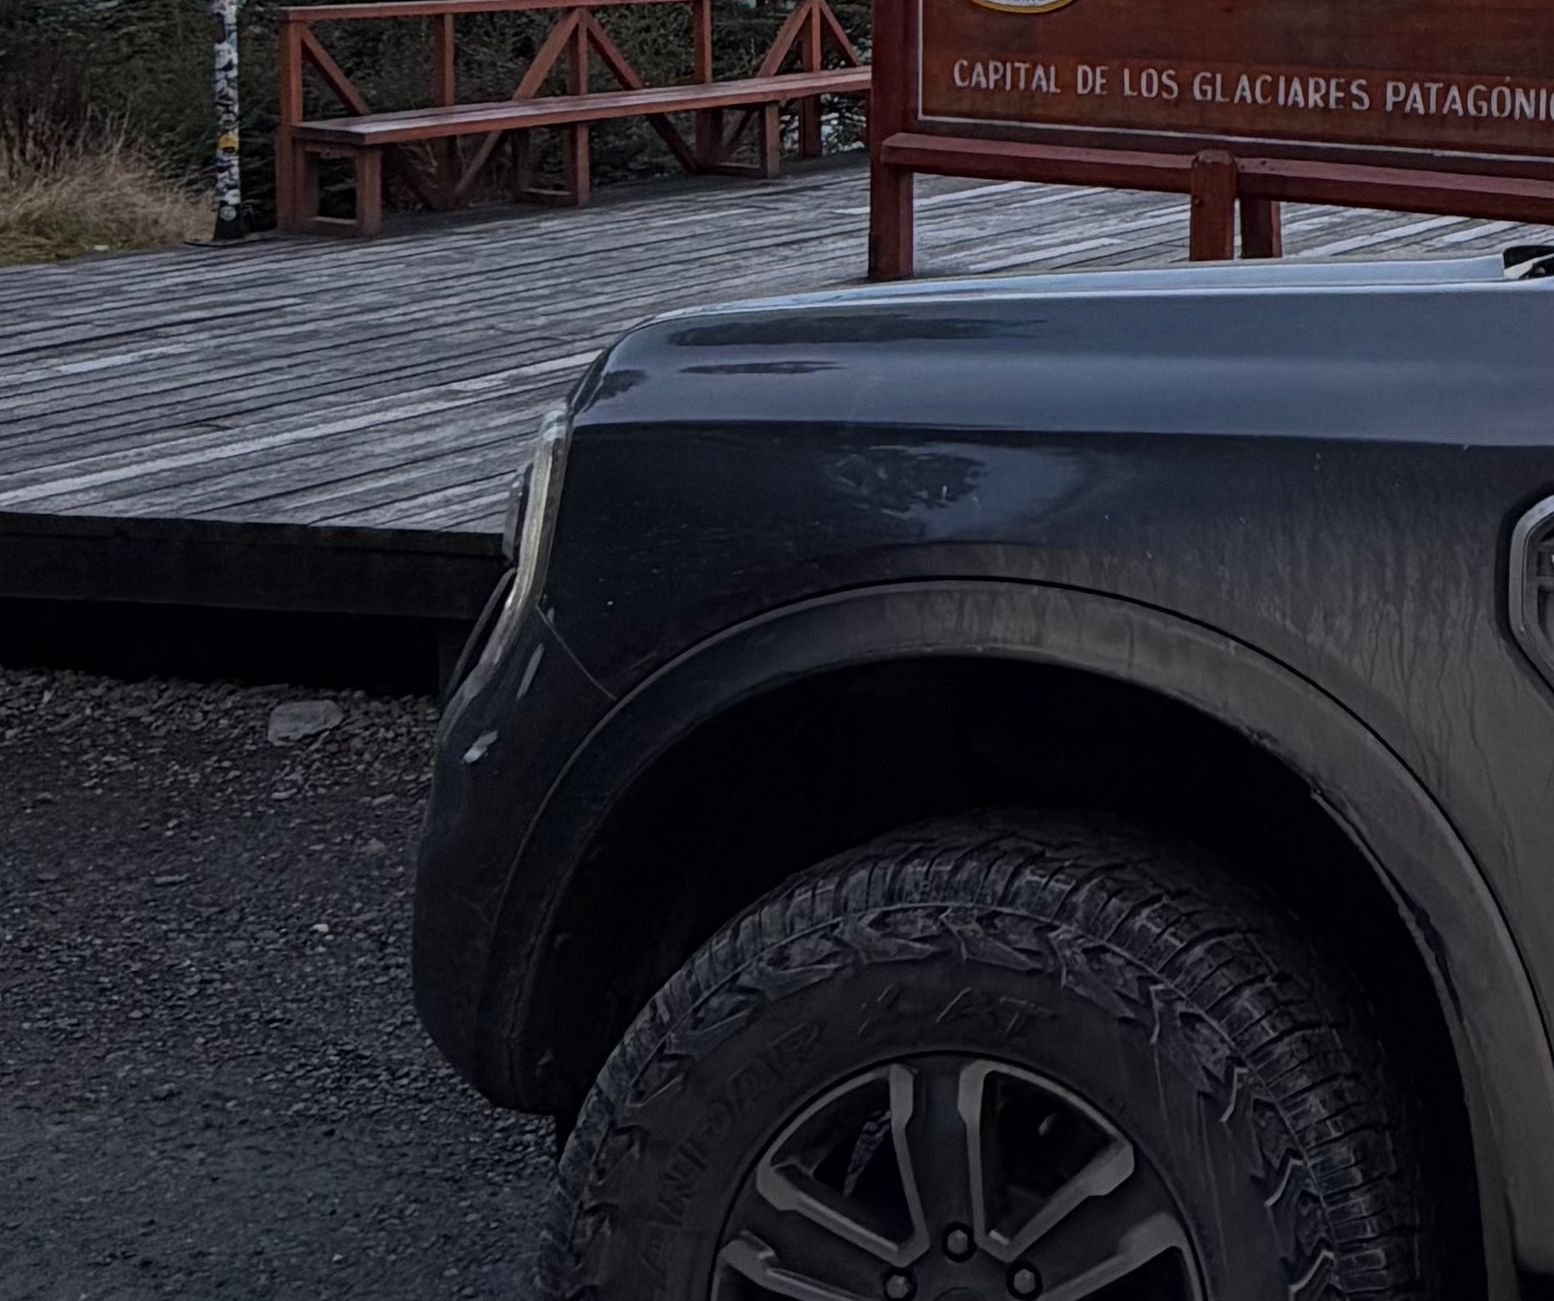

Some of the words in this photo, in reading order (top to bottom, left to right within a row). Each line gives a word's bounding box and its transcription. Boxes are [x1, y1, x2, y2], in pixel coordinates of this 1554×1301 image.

[952, 58, 1062, 94] CAPITAL
[1076, 63, 1109, 96] DE
[1122, 67, 1180, 100] LOS
[1191, 70, 1371, 111] GLACIARES
